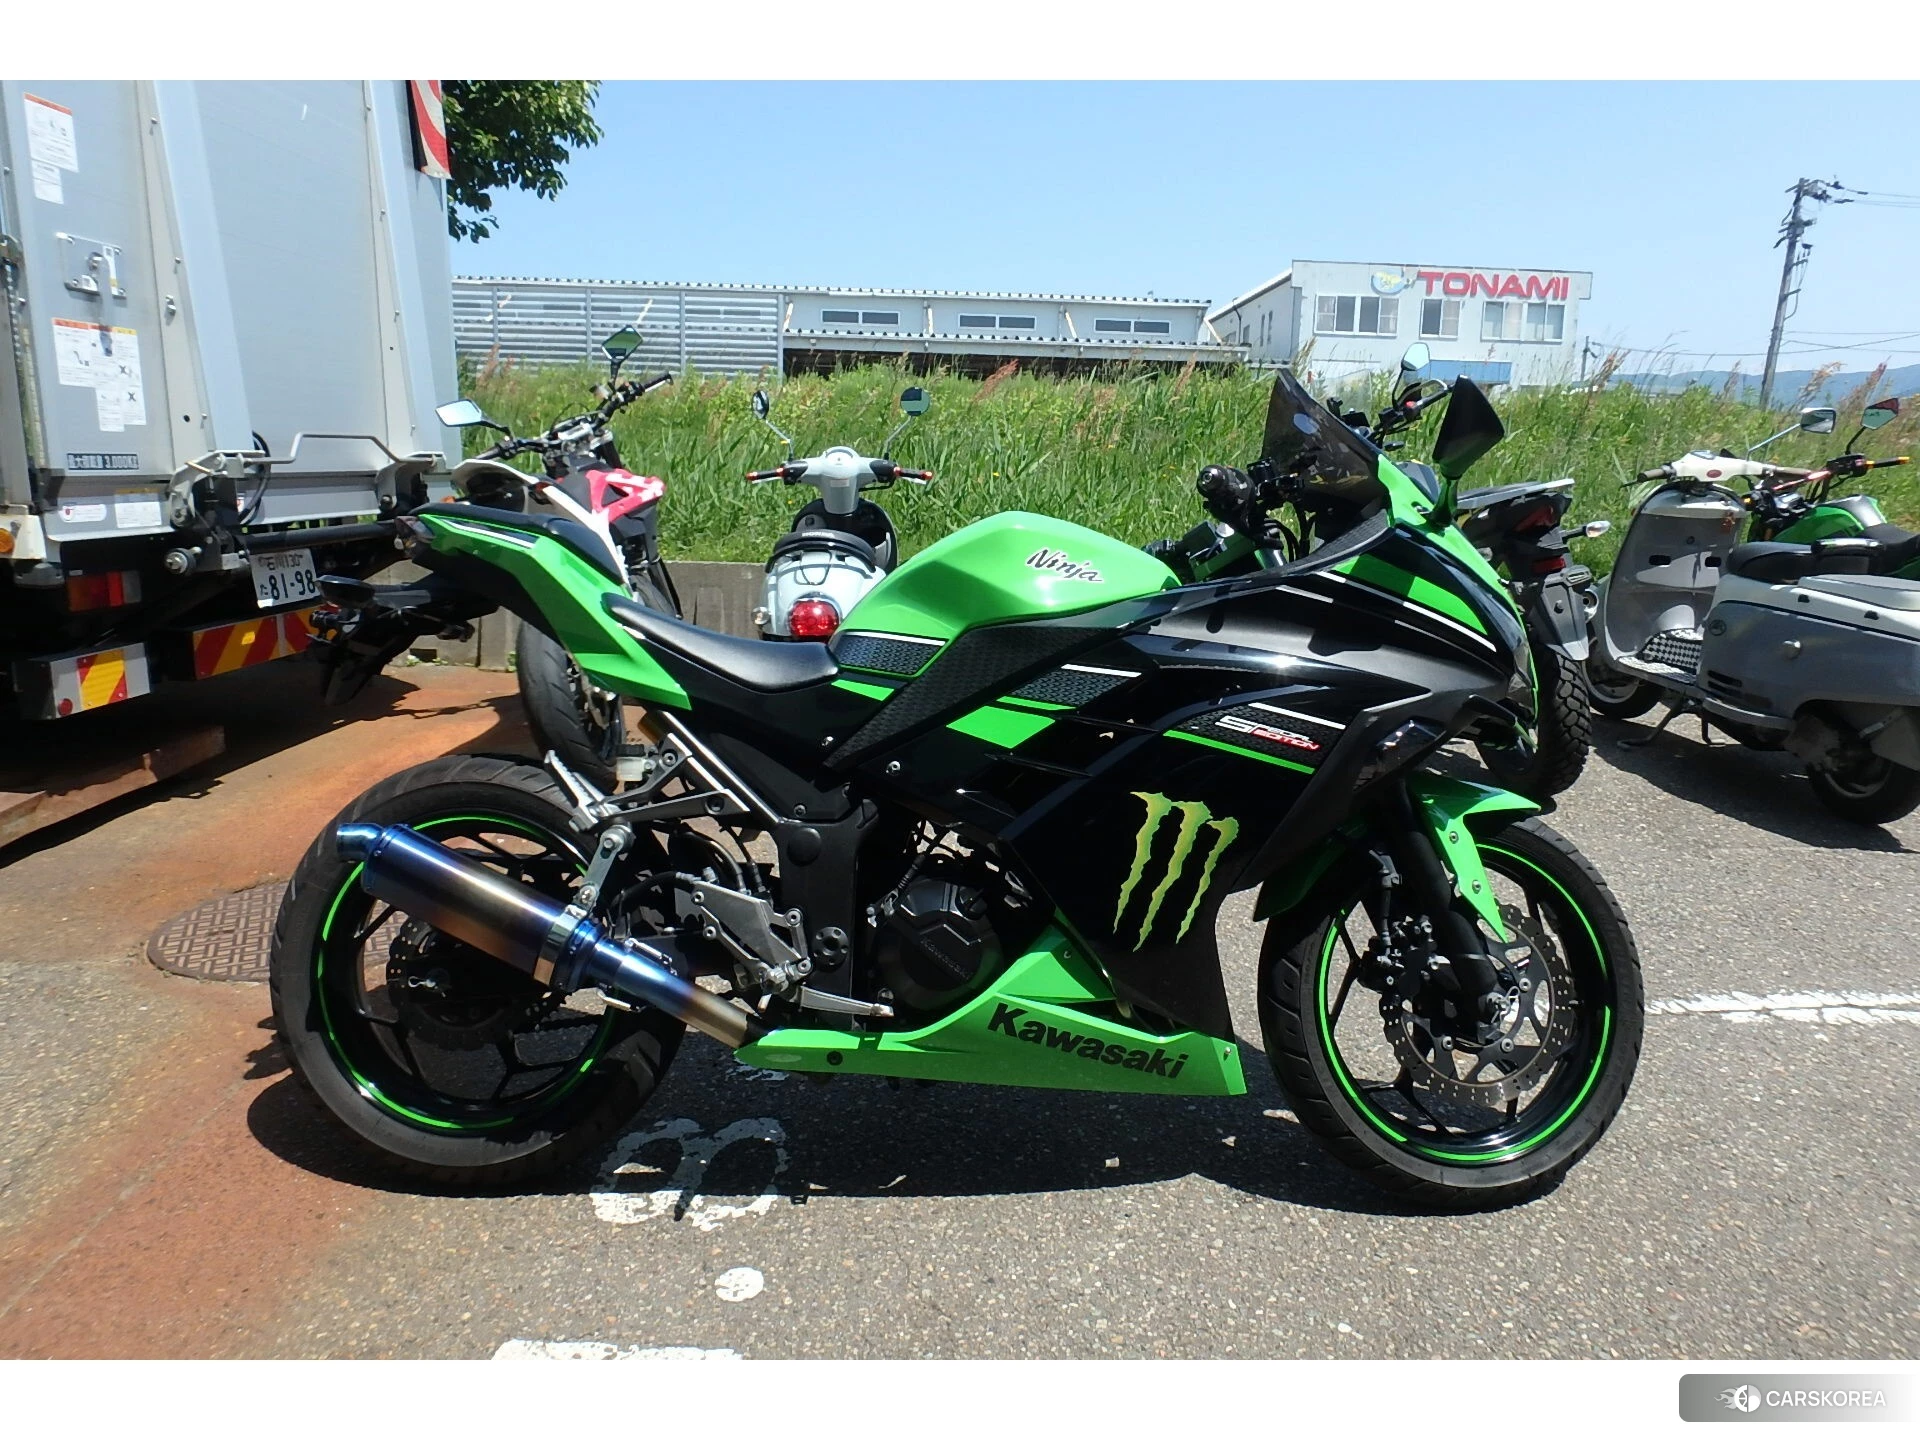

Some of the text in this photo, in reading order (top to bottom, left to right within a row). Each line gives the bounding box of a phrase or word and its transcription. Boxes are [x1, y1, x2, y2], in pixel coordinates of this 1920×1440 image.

[1417, 271, 1569, 301] TONAMI
[1026, 549, 1103, 582] Ninja
[269, 569, 316, 600] 81-98
[987, 1002, 1189, 1079] Kawasaki
